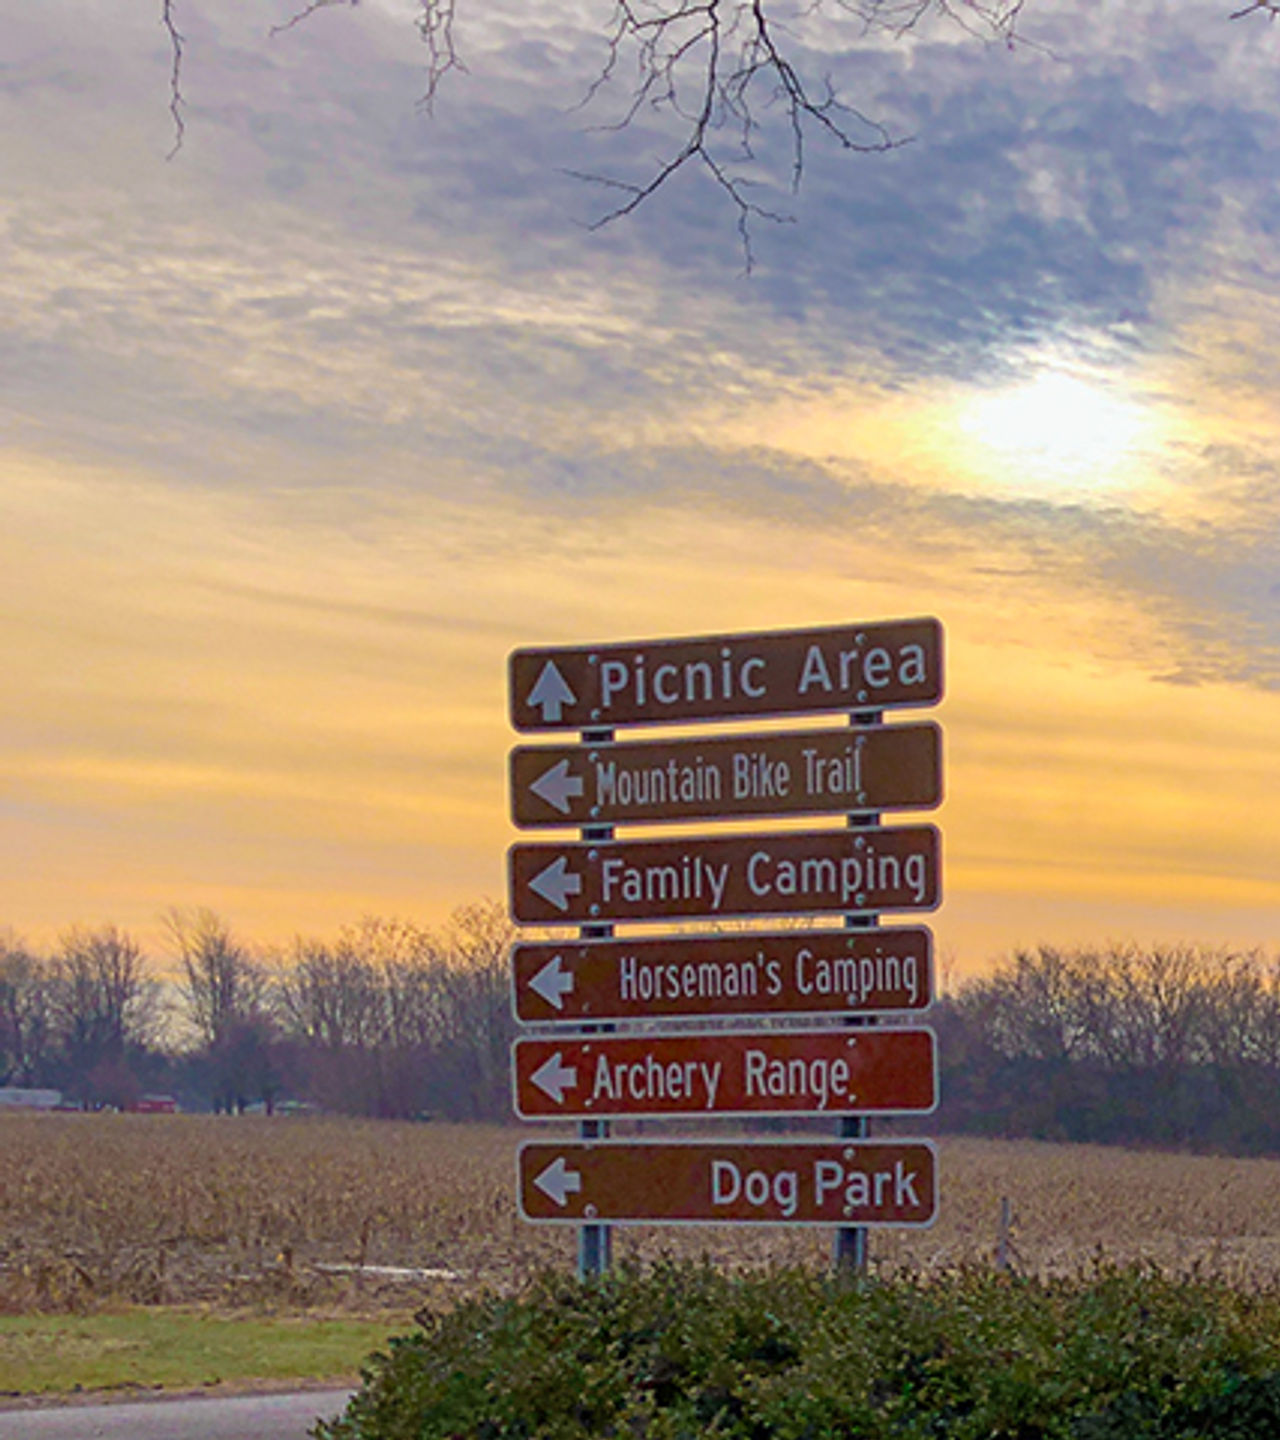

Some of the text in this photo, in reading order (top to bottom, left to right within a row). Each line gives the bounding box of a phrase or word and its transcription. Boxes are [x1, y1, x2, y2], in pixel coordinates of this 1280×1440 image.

[600, 642, 926, 706] Picnic Area
[596, 746, 862, 805] Mountain Bike Trail
[602, 846, 926, 908] Family Camping
[620, 948, 917, 1004] Horseman's Camping
[592, 1050, 849, 1110] Archery Range
[711, 1160, 920, 1216] Dog Park
